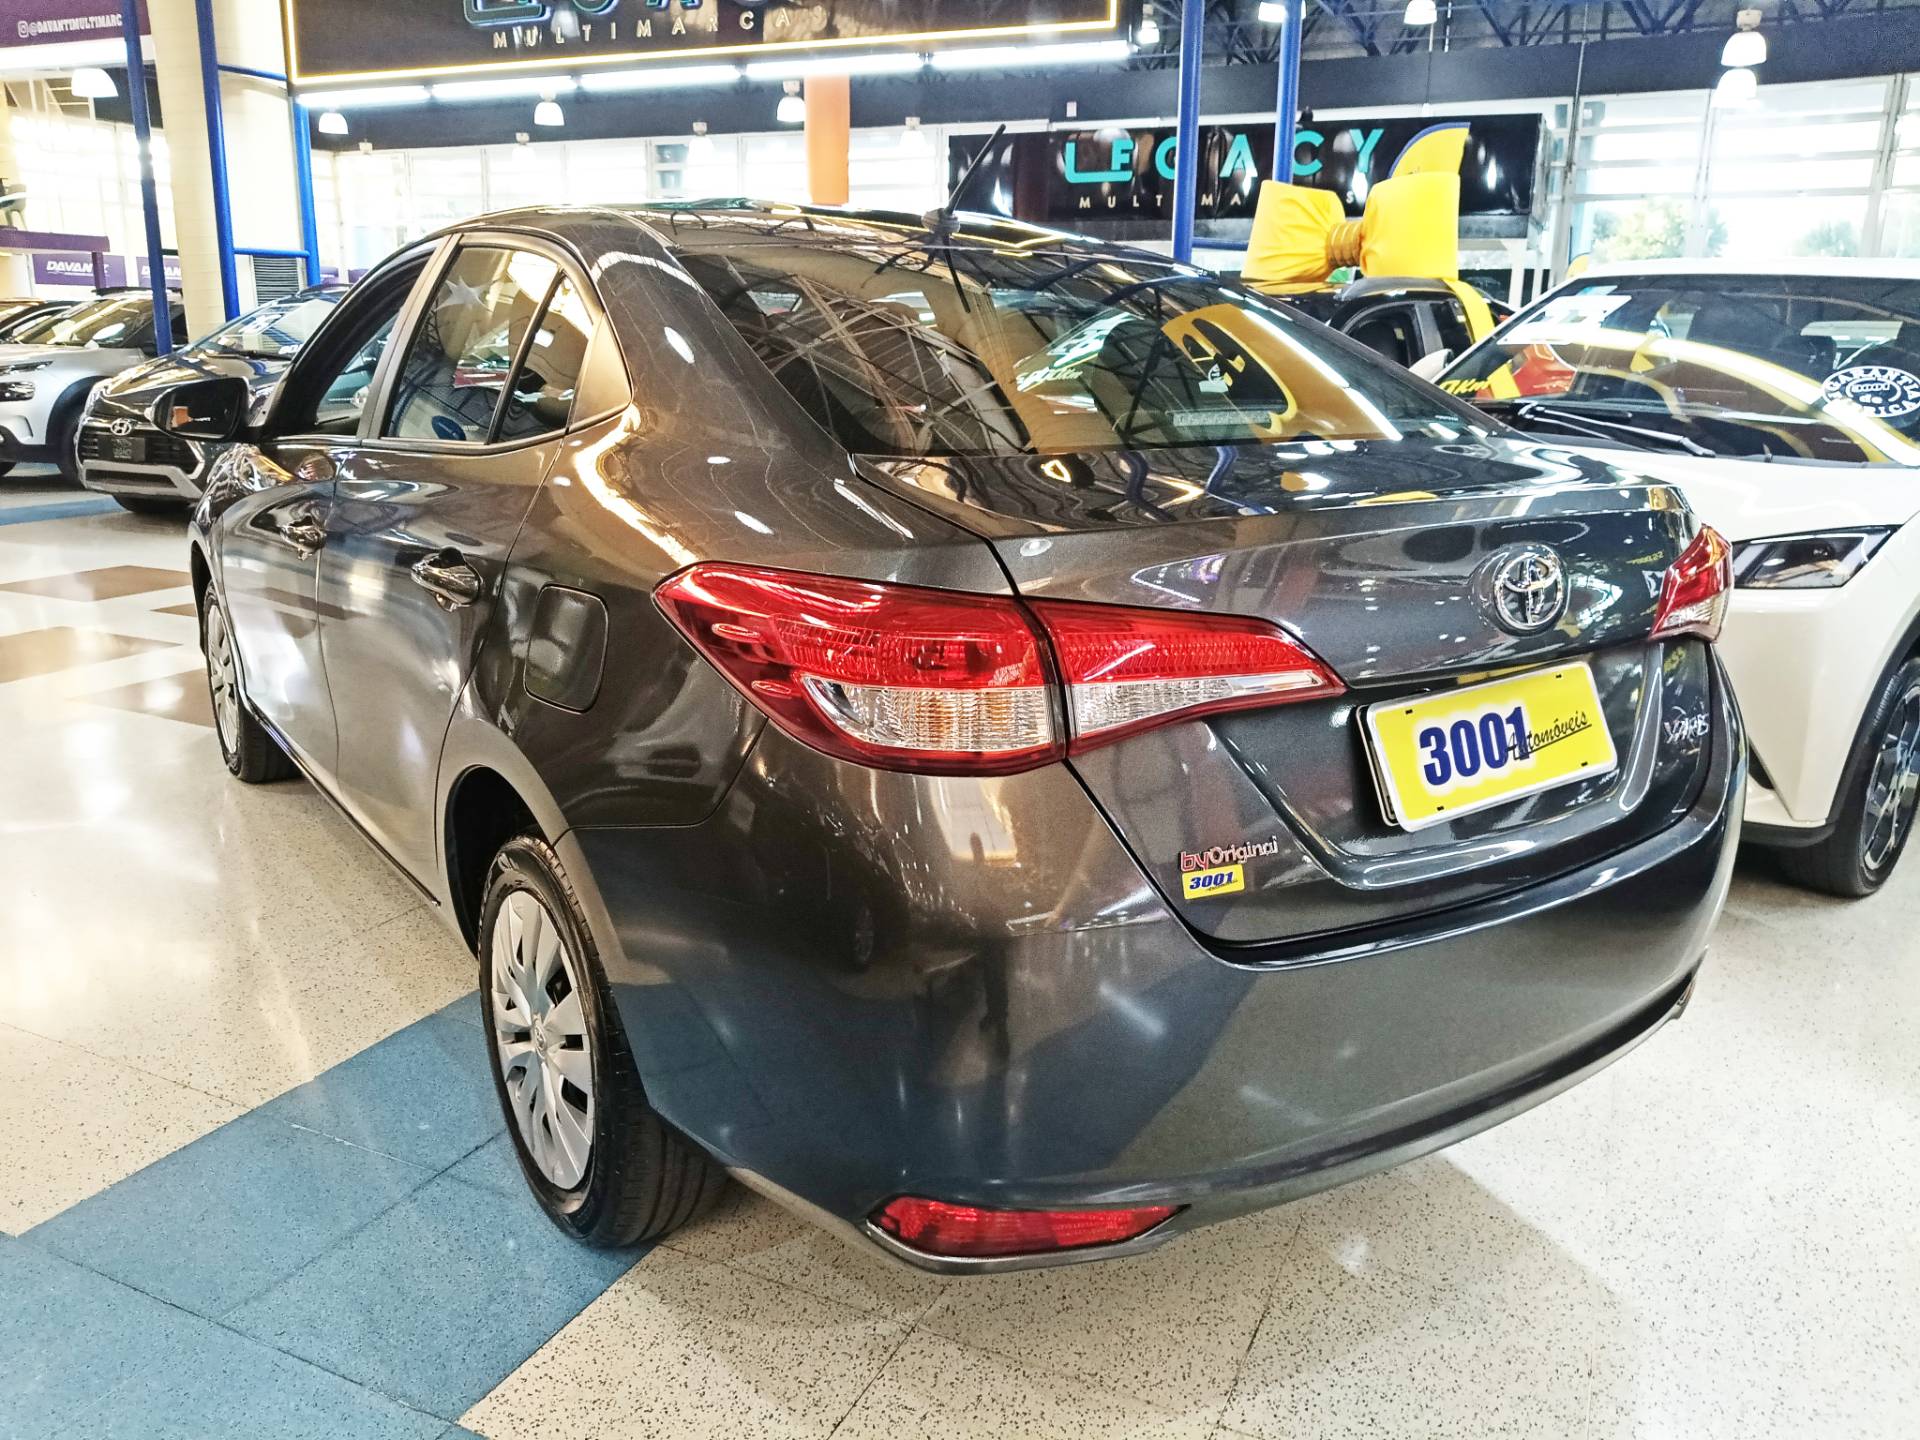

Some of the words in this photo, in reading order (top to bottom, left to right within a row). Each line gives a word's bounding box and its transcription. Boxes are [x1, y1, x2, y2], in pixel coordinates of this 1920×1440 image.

[1079, 192, 1354, 209] MULTMAS
[1419, 706, 1530, 786] 3001
[1189, 871, 1234, 890] 3001
